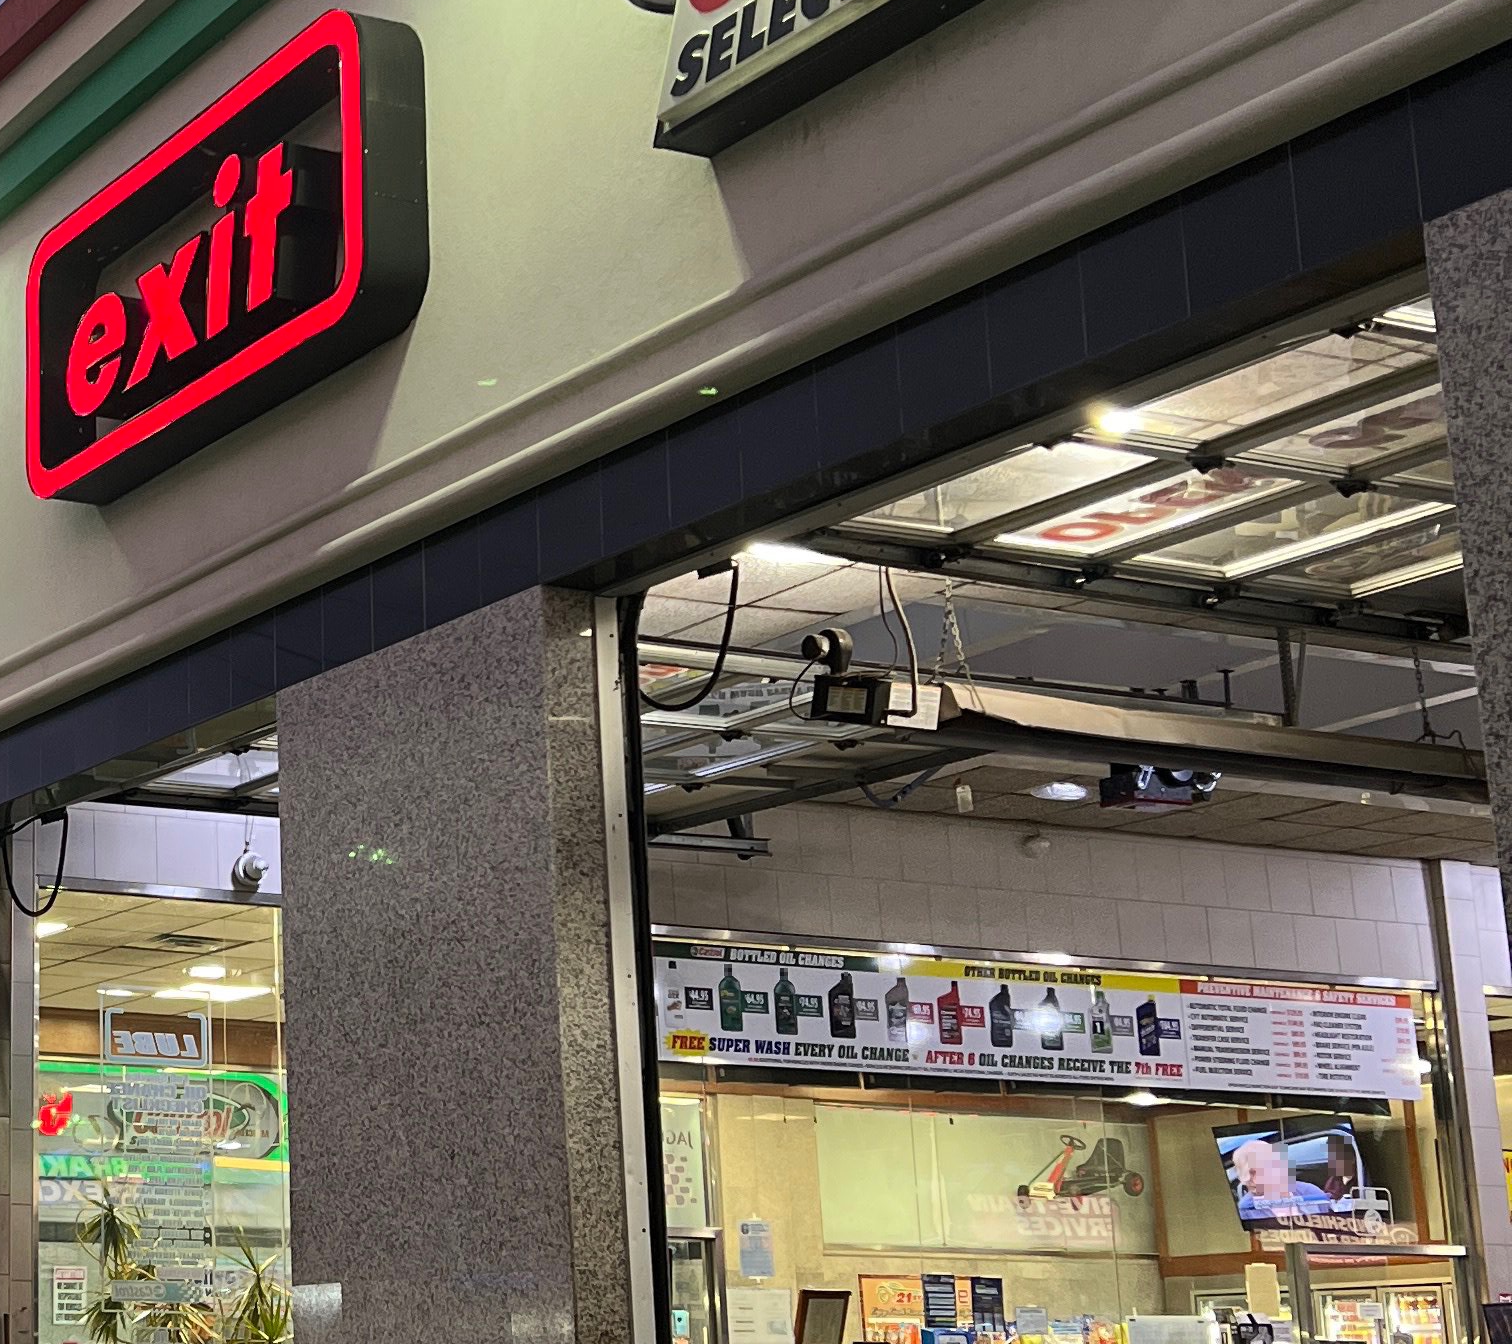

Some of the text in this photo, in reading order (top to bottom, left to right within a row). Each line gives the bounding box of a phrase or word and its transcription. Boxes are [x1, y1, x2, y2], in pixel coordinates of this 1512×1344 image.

[66, 142, 293, 416] exit
[730, 949, 777, 964] BOTTLED
[779, 951, 796, 965] OIL
[798, 954, 845, 969] CHANGES
[671, 1035, 706, 1051] FREE
[709, 1037, 751, 1053] SUPER
[755, 1040, 791, 1055] WASH
[794, 1042, 835, 1057] EVERY
[838, 1045, 858, 1060] OIL
[861, 1046, 910, 1062] CHANGE
[925, 1050, 964, 1066] AFTER
[979, 1054, 999, 1067] OIL
[1001, 1055, 1055, 1071] CHANGES
[1058, 1058, 1106, 1073] RECEIVE
[1109, 1061, 1132, 1074] THE
[1135, 1062, 1152, 1075] 7th
[1155, 1063, 1183, 1077] FREE
